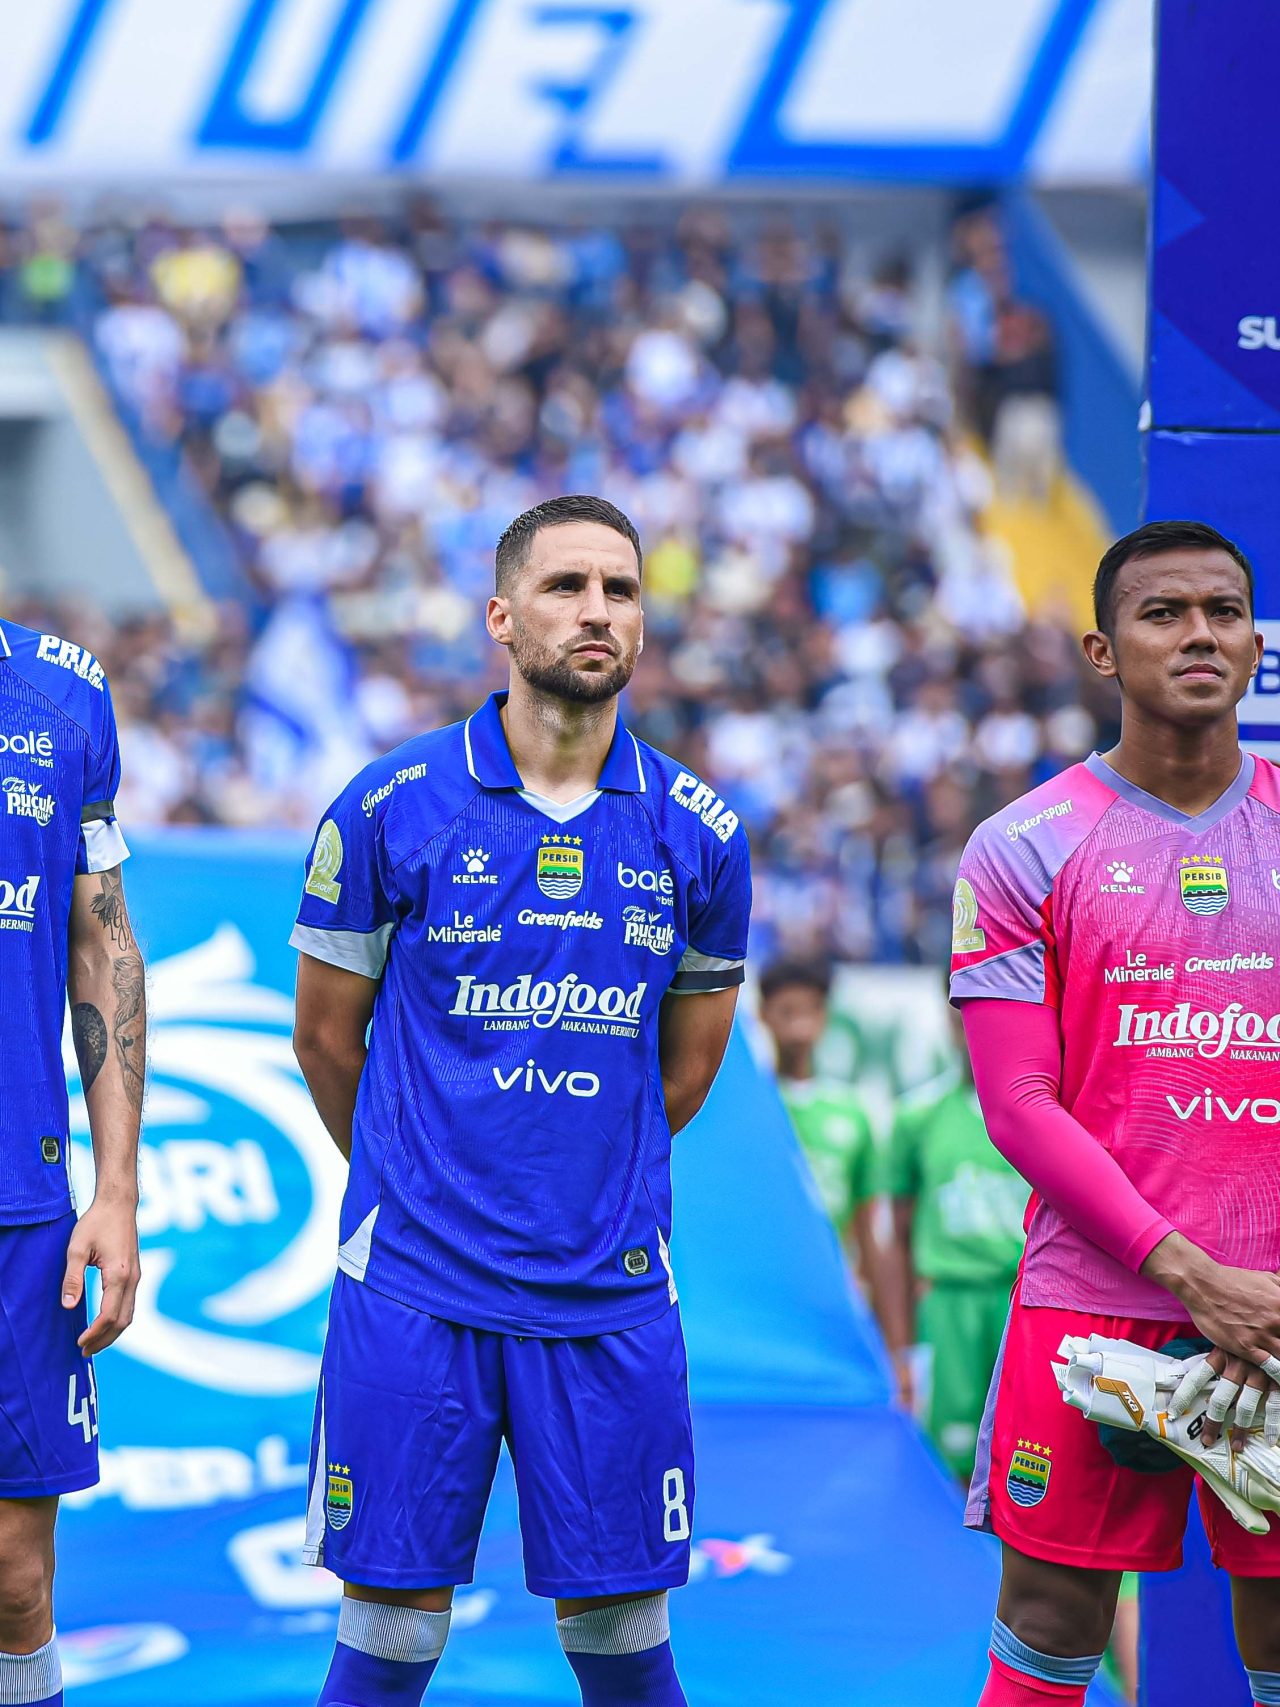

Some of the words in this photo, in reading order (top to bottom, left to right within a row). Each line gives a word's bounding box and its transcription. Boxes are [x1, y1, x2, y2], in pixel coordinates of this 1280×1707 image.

[36, 650, 72, 670] PUNYA
[39, 634, 106, 681] PRIA
[669, 787, 701, 814] PUNYA
[671, 771, 739, 837] PRIA
[542, 853, 578, 863] PERSIB
[452, 874, 498, 885] KELME
[1185, 873, 1221, 881] PERSIB
[1101, 884, 1145, 894] KELME
[455, 911, 474, 928] Le
[518, 910, 603, 930] Greenfields
[428, 924, 501, 943] Minerale
[633, 937, 671, 955] HARUM
[1127, 950, 1147, 968] Le
[1185, 952, 1274, 973] Greenfields
[1105, 962, 1175, 984] Minerale
[449, 973, 646, 1029] Indofood
[483, 1020, 529, 1031] LAMBANG
[561, 1023, 608, 1036] MAKANAN
[1146, 1048, 1194, 1058] LAMBANG
[493, 1060, 600, 1097] vivo
[1015, 1456, 1046, 1473] PERSIB
[663, 1467, 689, 1542] 8
